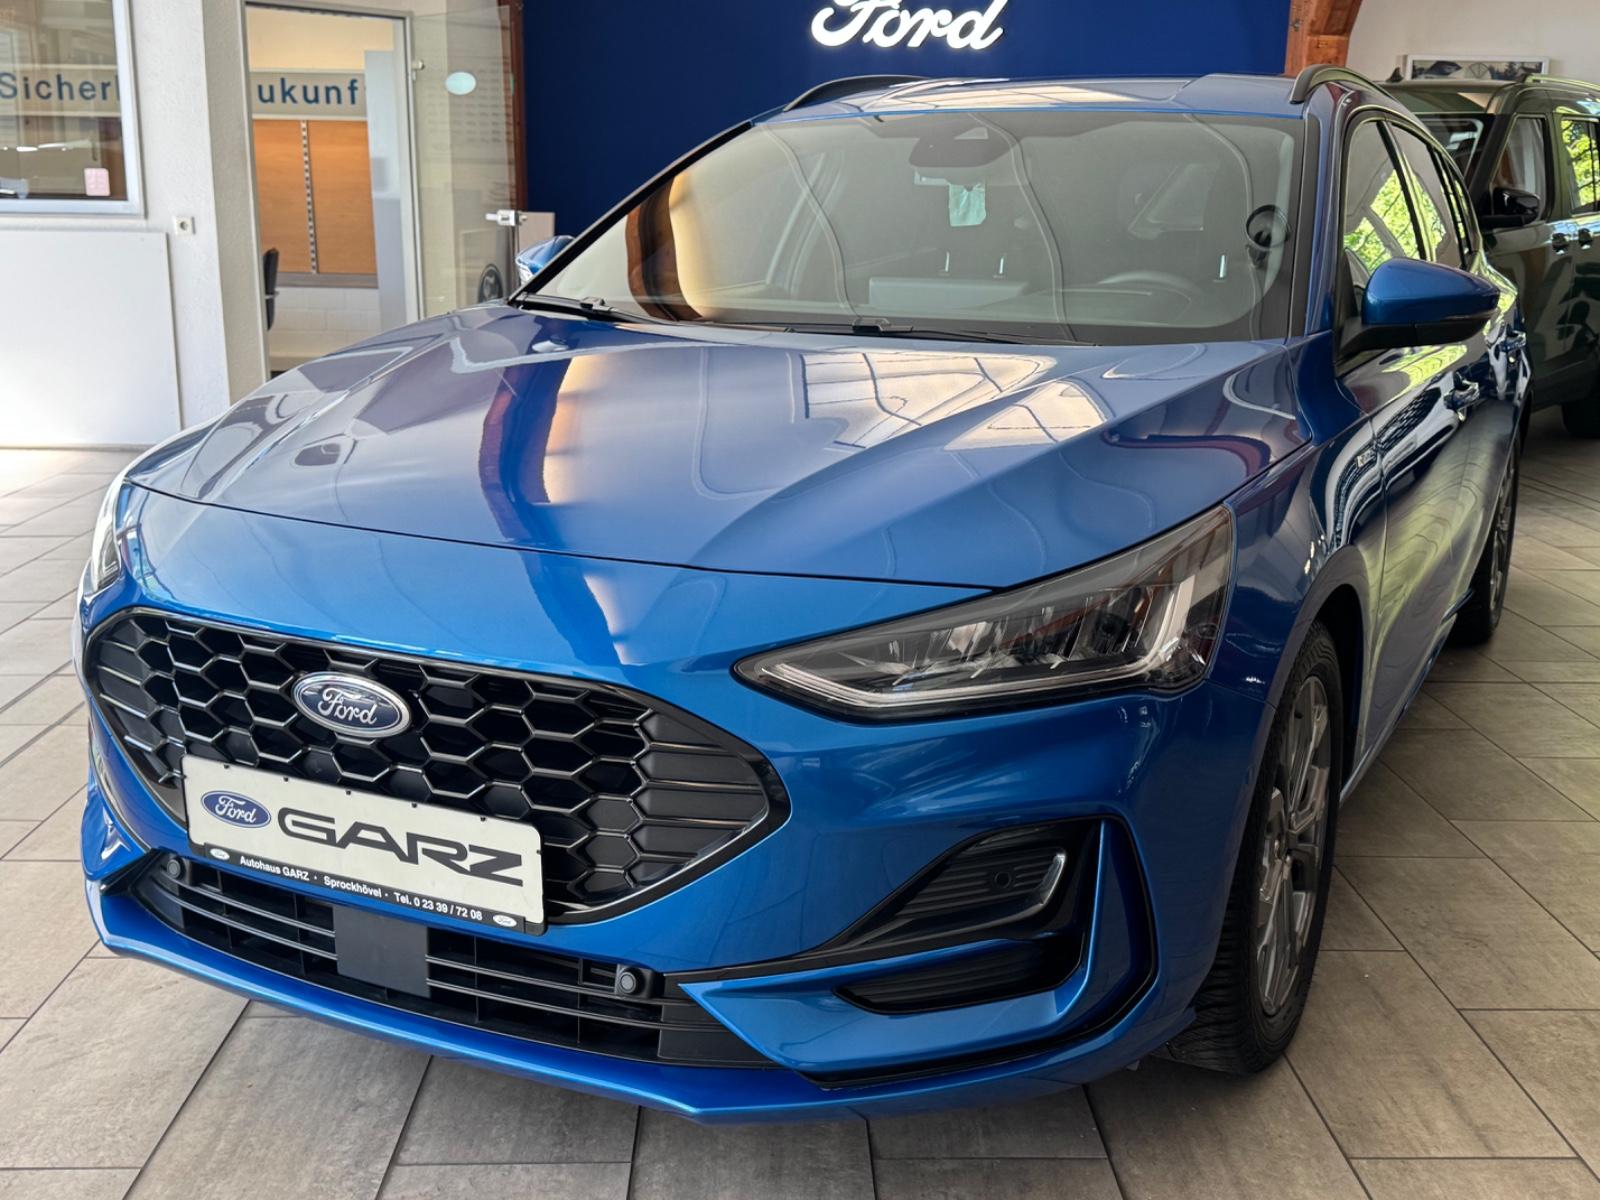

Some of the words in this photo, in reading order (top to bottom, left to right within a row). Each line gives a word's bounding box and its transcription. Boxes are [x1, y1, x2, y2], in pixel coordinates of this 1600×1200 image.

[811, 0, 1006, 50] Ford
[0, 72, 120, 101] Sicher
[256, 77, 359, 105] ukunf
[317, 687, 378, 725] Ford
[214, 795, 257, 824] Ford
[278, 807, 523, 887] GARZ
[240, 856, 281, 875] Autohaus
[282, 867, 309, 881] GARZ
[323, 875, 382, 898] Sprockhövel
[394, 892, 412, 905] Tel.
[413, 897, 421, 907] 0
[422, 899, 434, 910] 23
[455, 906, 469, 918] 72
[470, 909, 483, 921] 08
